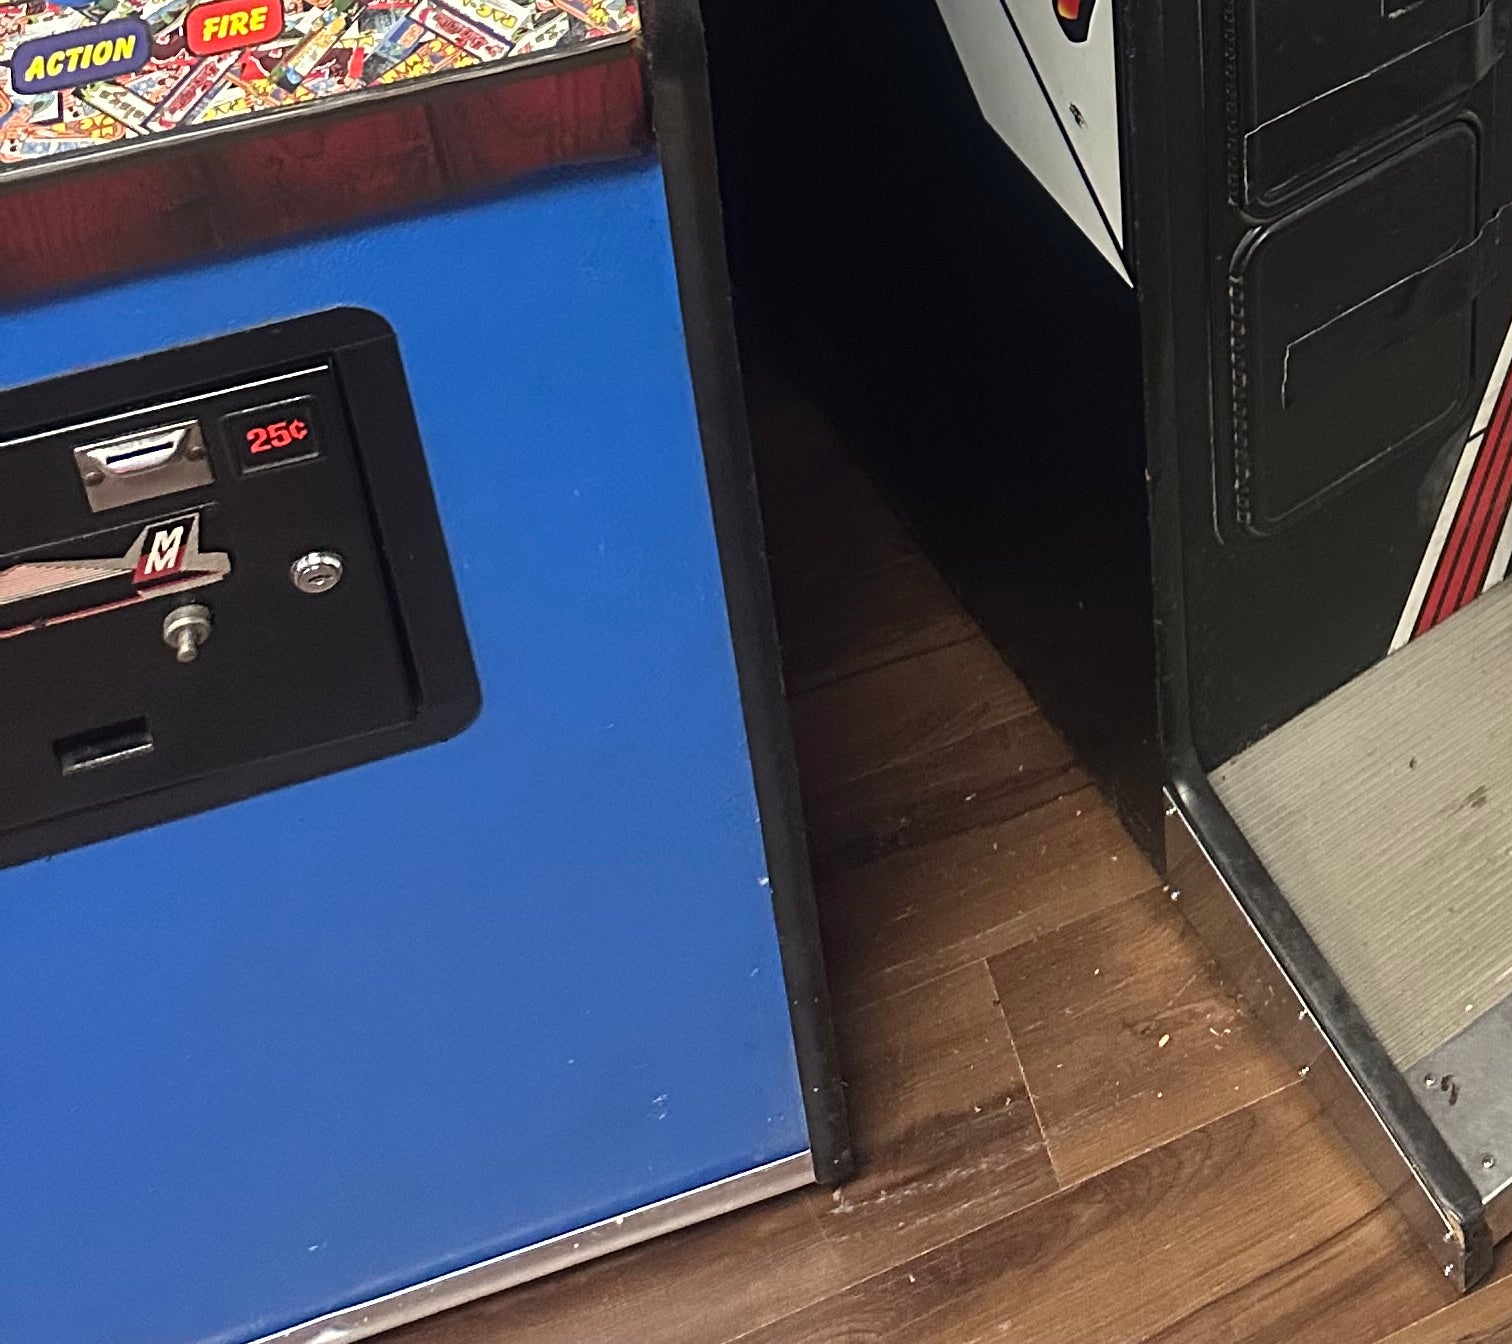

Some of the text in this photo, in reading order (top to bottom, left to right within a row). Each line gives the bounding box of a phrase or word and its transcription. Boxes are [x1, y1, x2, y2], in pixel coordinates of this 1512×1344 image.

[202, 6, 268, 42] FIRE
[24, 35, 137, 82] ACTION
[246, 419, 308, 454] 25¢
